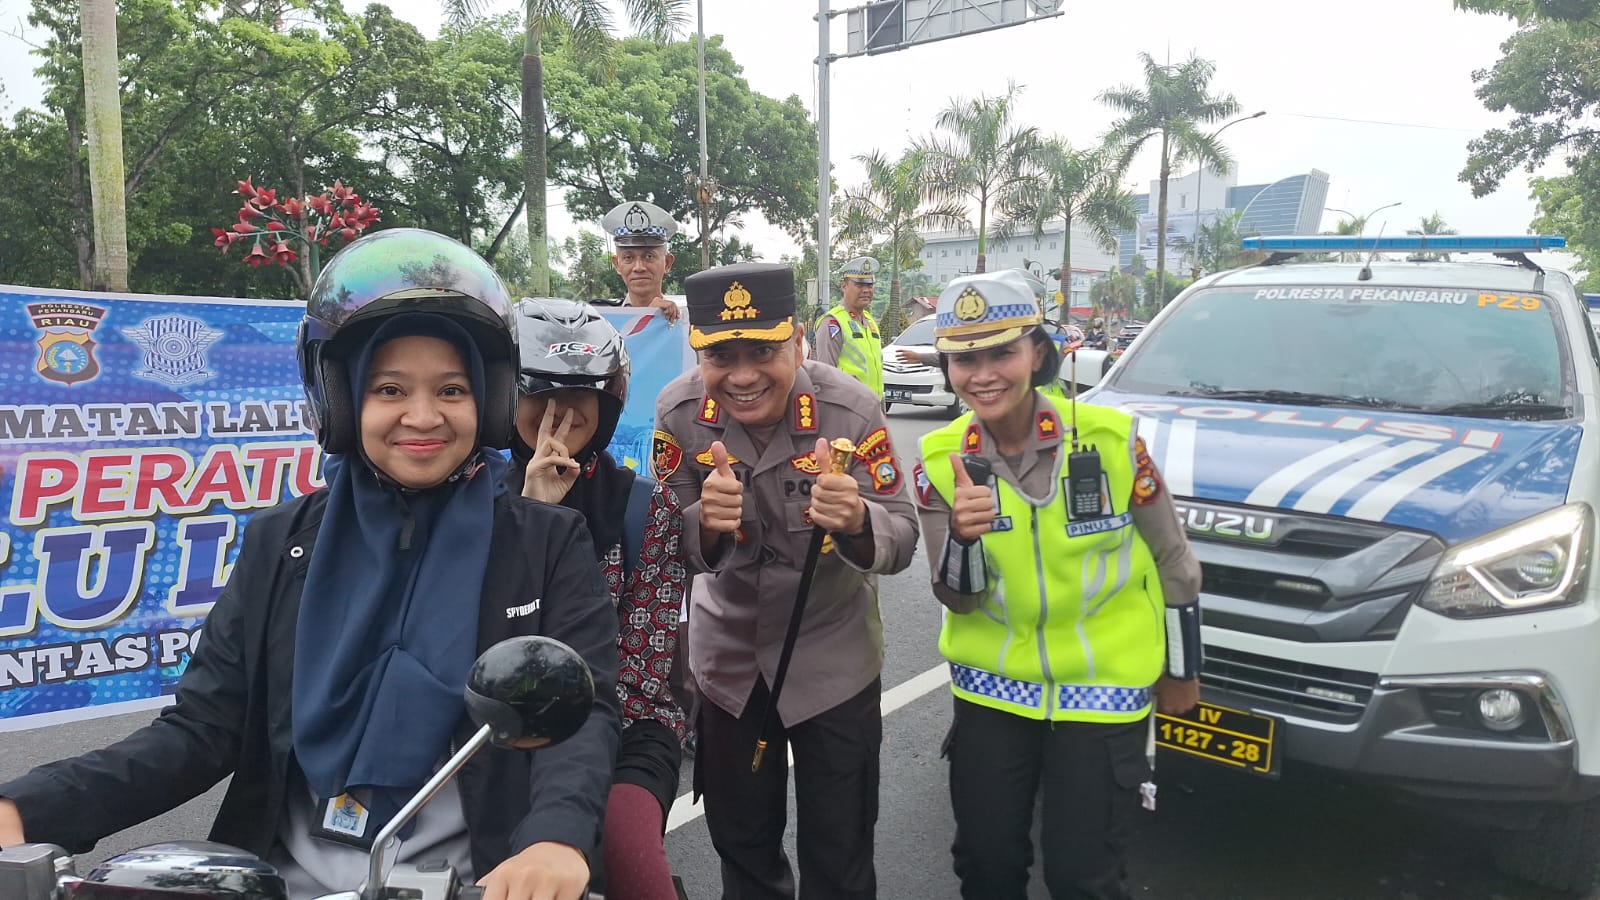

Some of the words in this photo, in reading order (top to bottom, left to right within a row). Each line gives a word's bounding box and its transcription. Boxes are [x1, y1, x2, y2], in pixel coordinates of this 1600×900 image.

[1255, 288, 1344, 300] POLRESTA
[1350, 288, 1468, 305] PEKANBARU
[1477, 293, 1541, 311] PZ9
[40, 303, 91, 311] POLRESTA
[40, 318, 90, 328] RIAU
[1121, 402, 1502, 449] POLISI
[1070, 520, 1113, 535] PINUS
[1199, 707, 1223, 724] IV
[1160, 723, 1213, 750] 1127
[1231, 740, 1261, 762] 28
